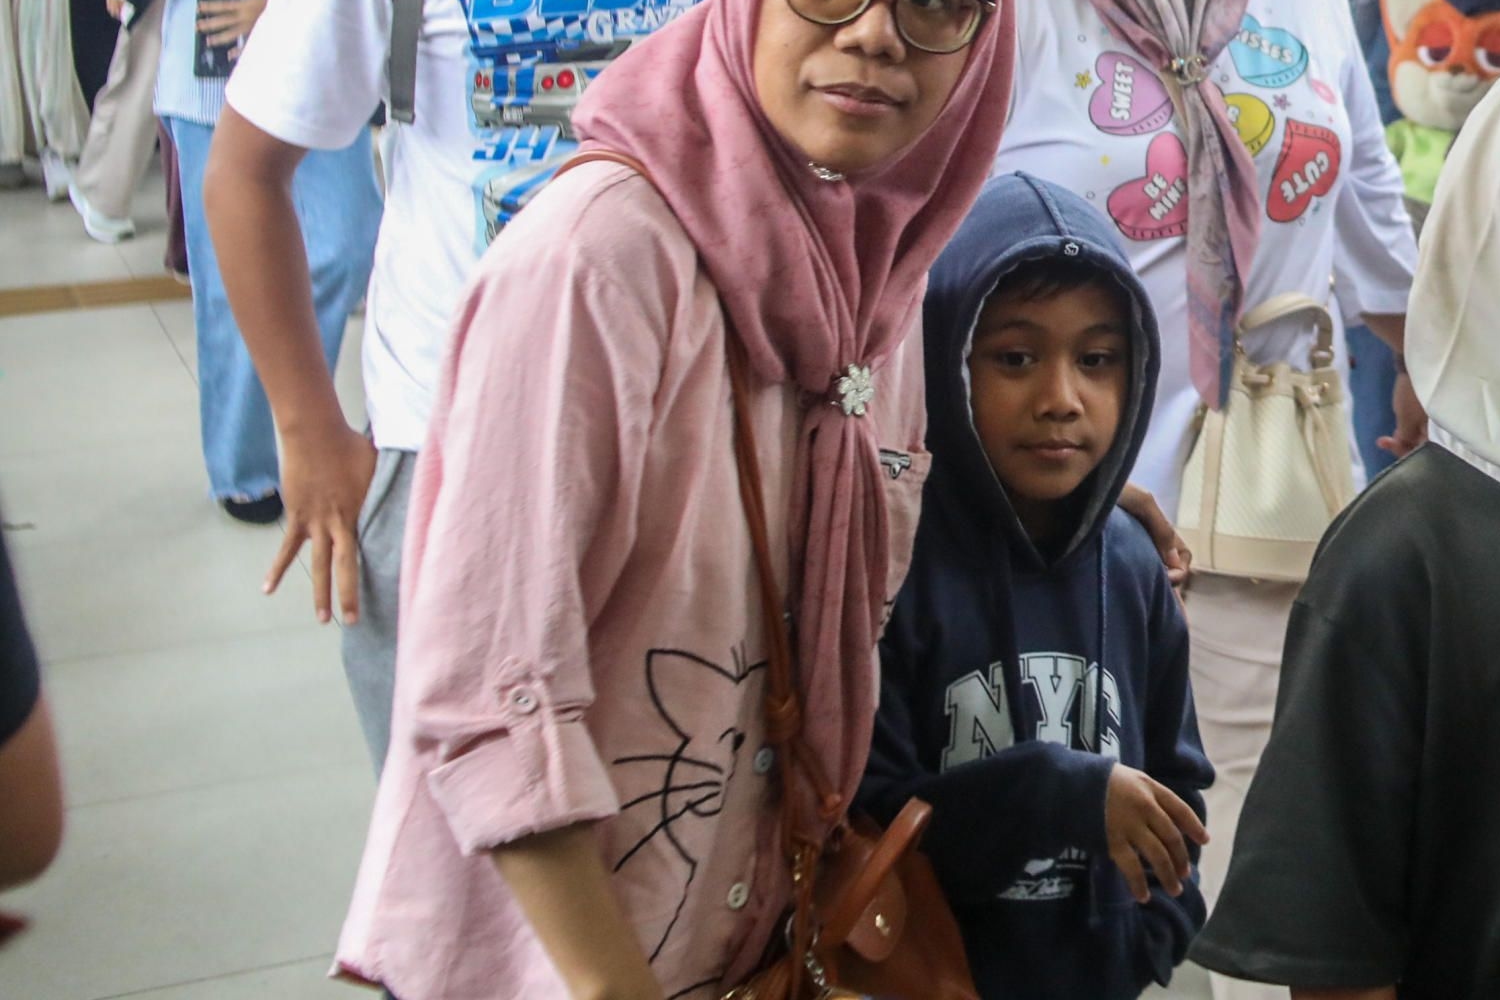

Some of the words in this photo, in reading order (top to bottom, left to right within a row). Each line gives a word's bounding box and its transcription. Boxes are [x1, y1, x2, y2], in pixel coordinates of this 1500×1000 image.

[1235, 29, 1294, 64] ISSES
[1110, 60, 1134, 121] SWEET
[1143, 172, 1168, 201] BE
[1149, 176, 1186, 221] MINE
[1280, 150, 1329, 204] CUTE
[940, 651, 1121, 774] NYC
